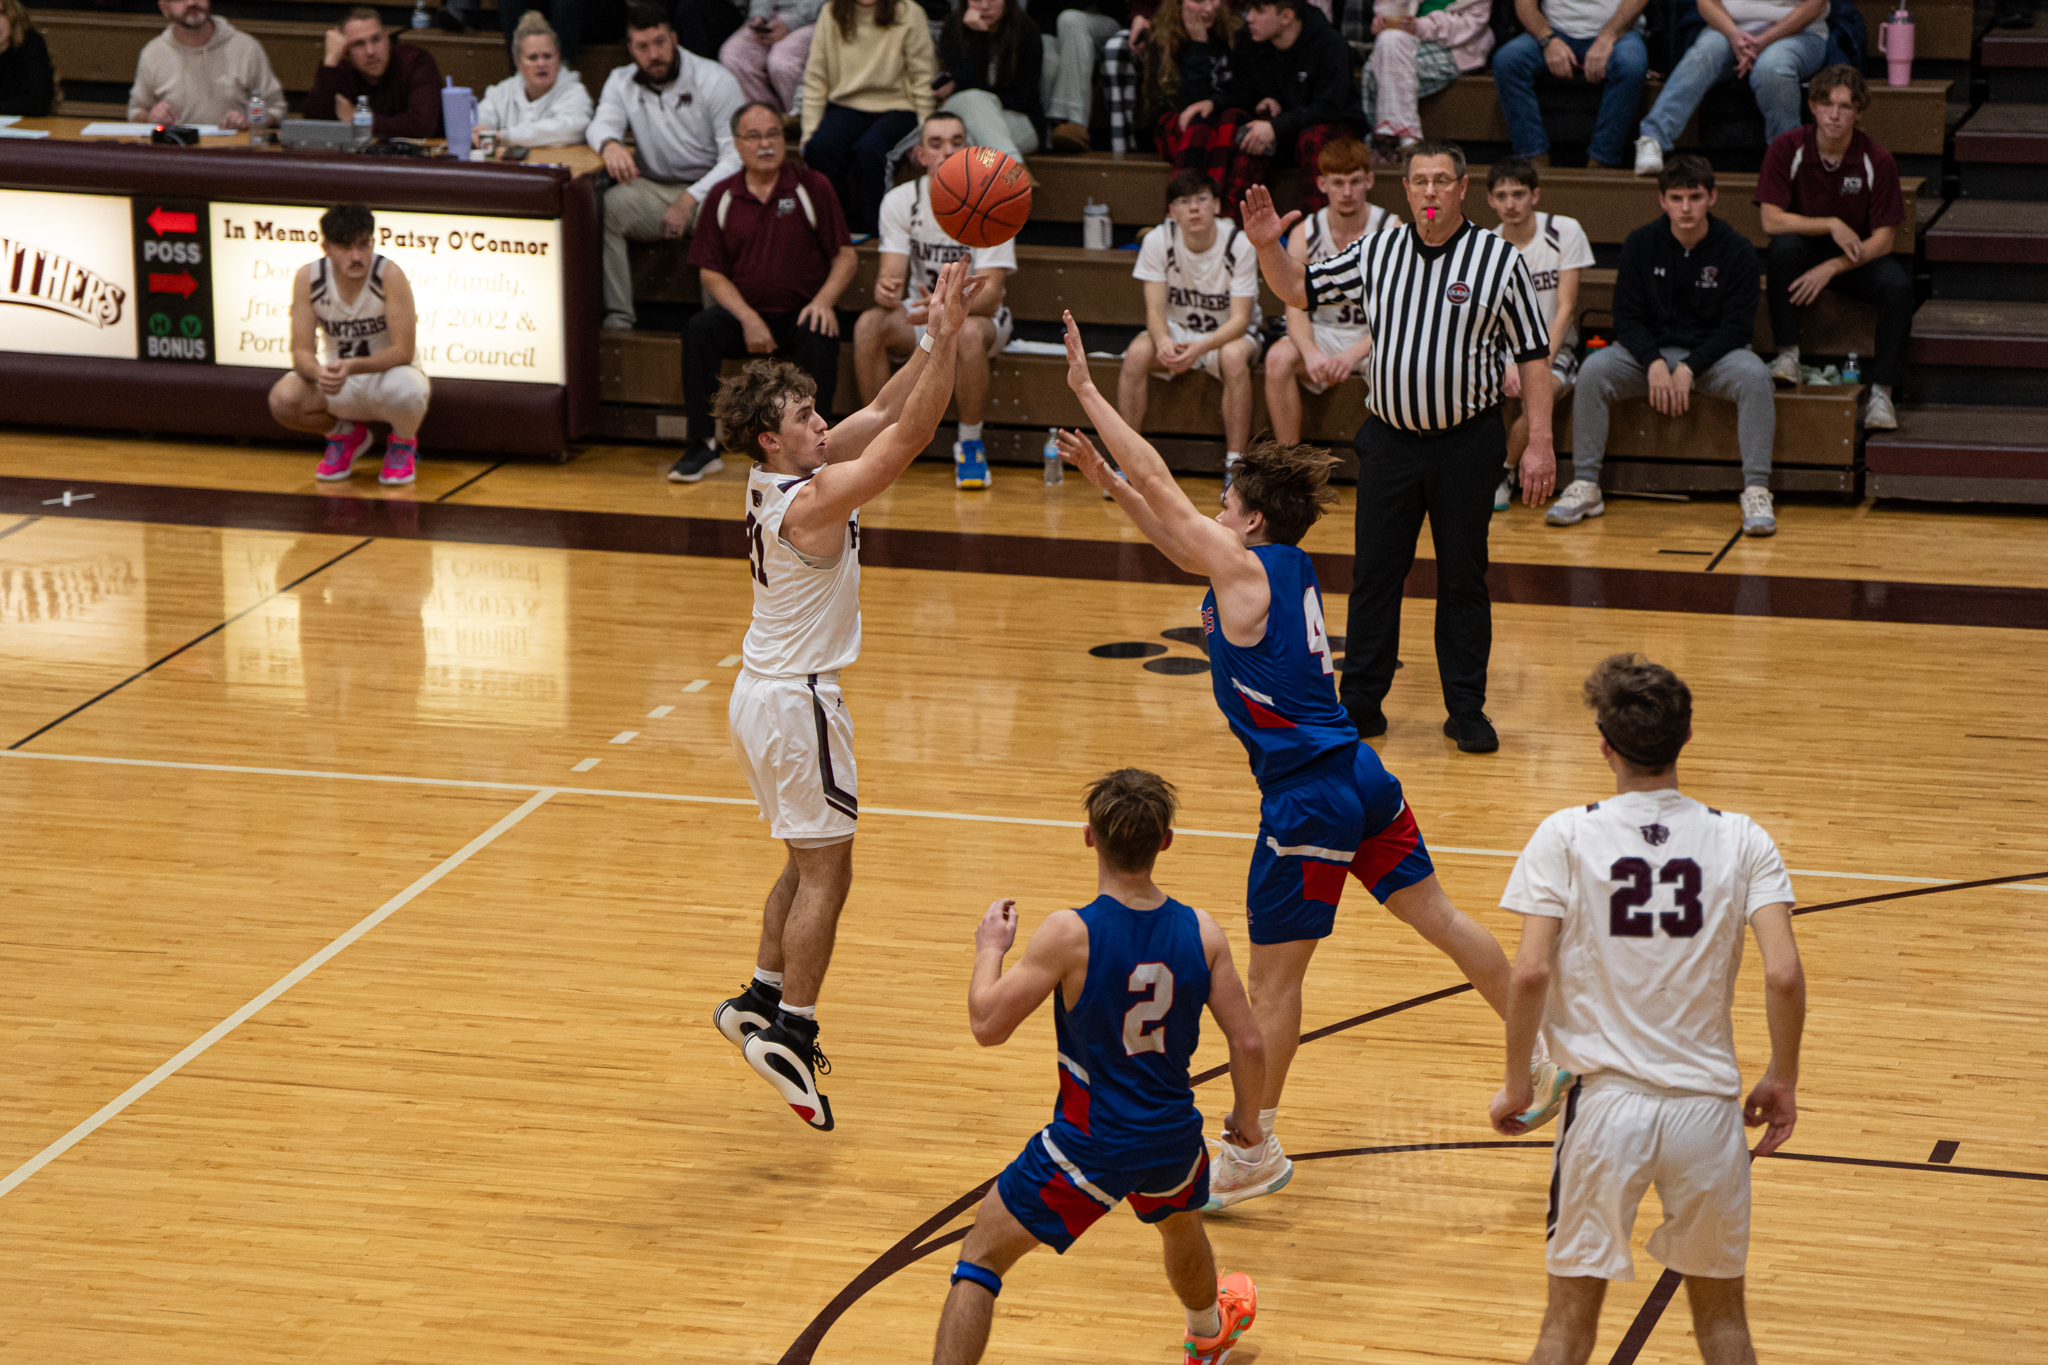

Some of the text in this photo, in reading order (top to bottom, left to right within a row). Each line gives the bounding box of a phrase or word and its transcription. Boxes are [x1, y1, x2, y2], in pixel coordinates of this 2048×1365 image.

[144, 240, 201, 264] POSS
[224, 219, 549, 256] In Memo Patsy O'Connor
[0, 237, 126, 325] NTHERS
[240, 295, 292, 322] frie
[447, 307, 508, 331] 2002
[516, 310, 538, 332] &
[148, 335, 206, 359] BONUS
[238, 330, 292, 354] Port
[446, 342, 537, 368] Council
[1303, 584, 1334, 676] 4
[1610, 857, 1704, 938] 23
[1122, 961, 1174, 1057] 2
